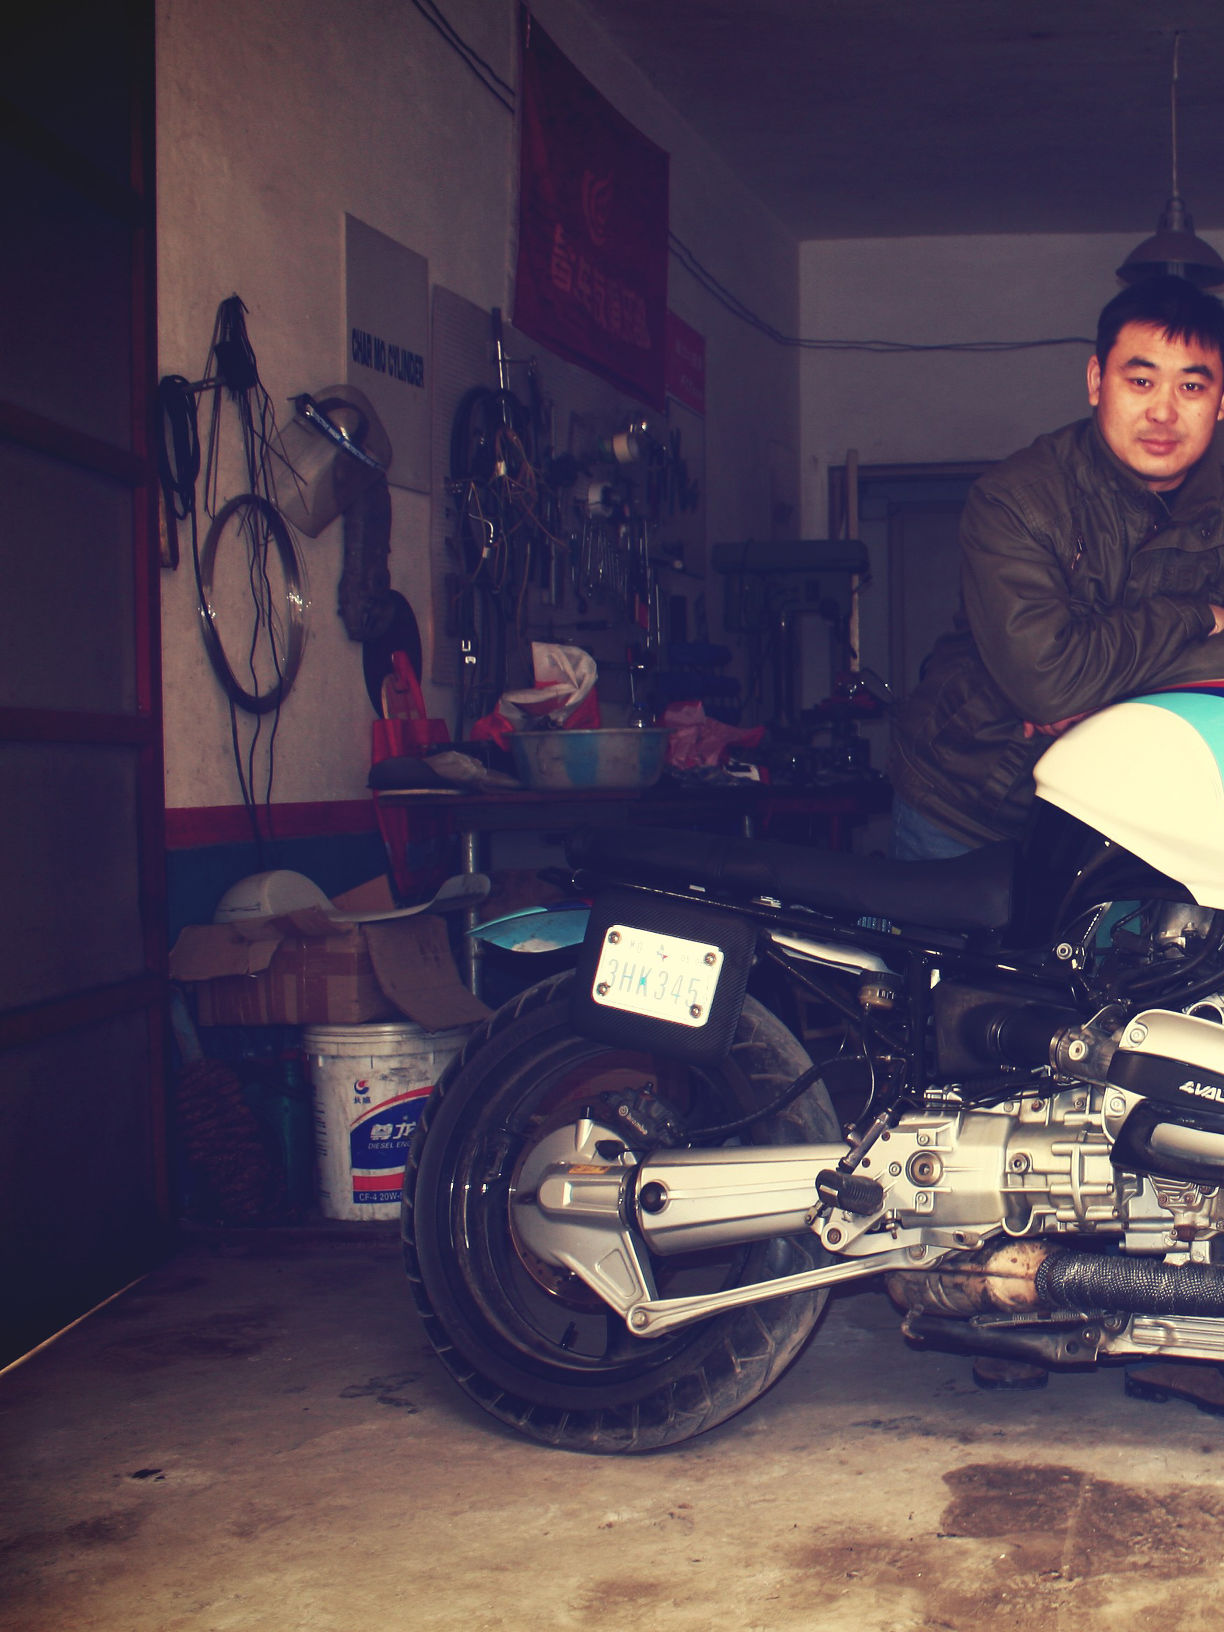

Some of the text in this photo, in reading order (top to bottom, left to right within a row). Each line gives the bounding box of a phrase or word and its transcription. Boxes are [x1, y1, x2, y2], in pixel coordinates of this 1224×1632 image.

[388, 343, 424, 388] CYLINDER
[608, 958, 700, 1008] 3HK345
[368, 1142, 393, 1150] DIESEL
[359, 1191, 402, 1201] CF-4 20W-
